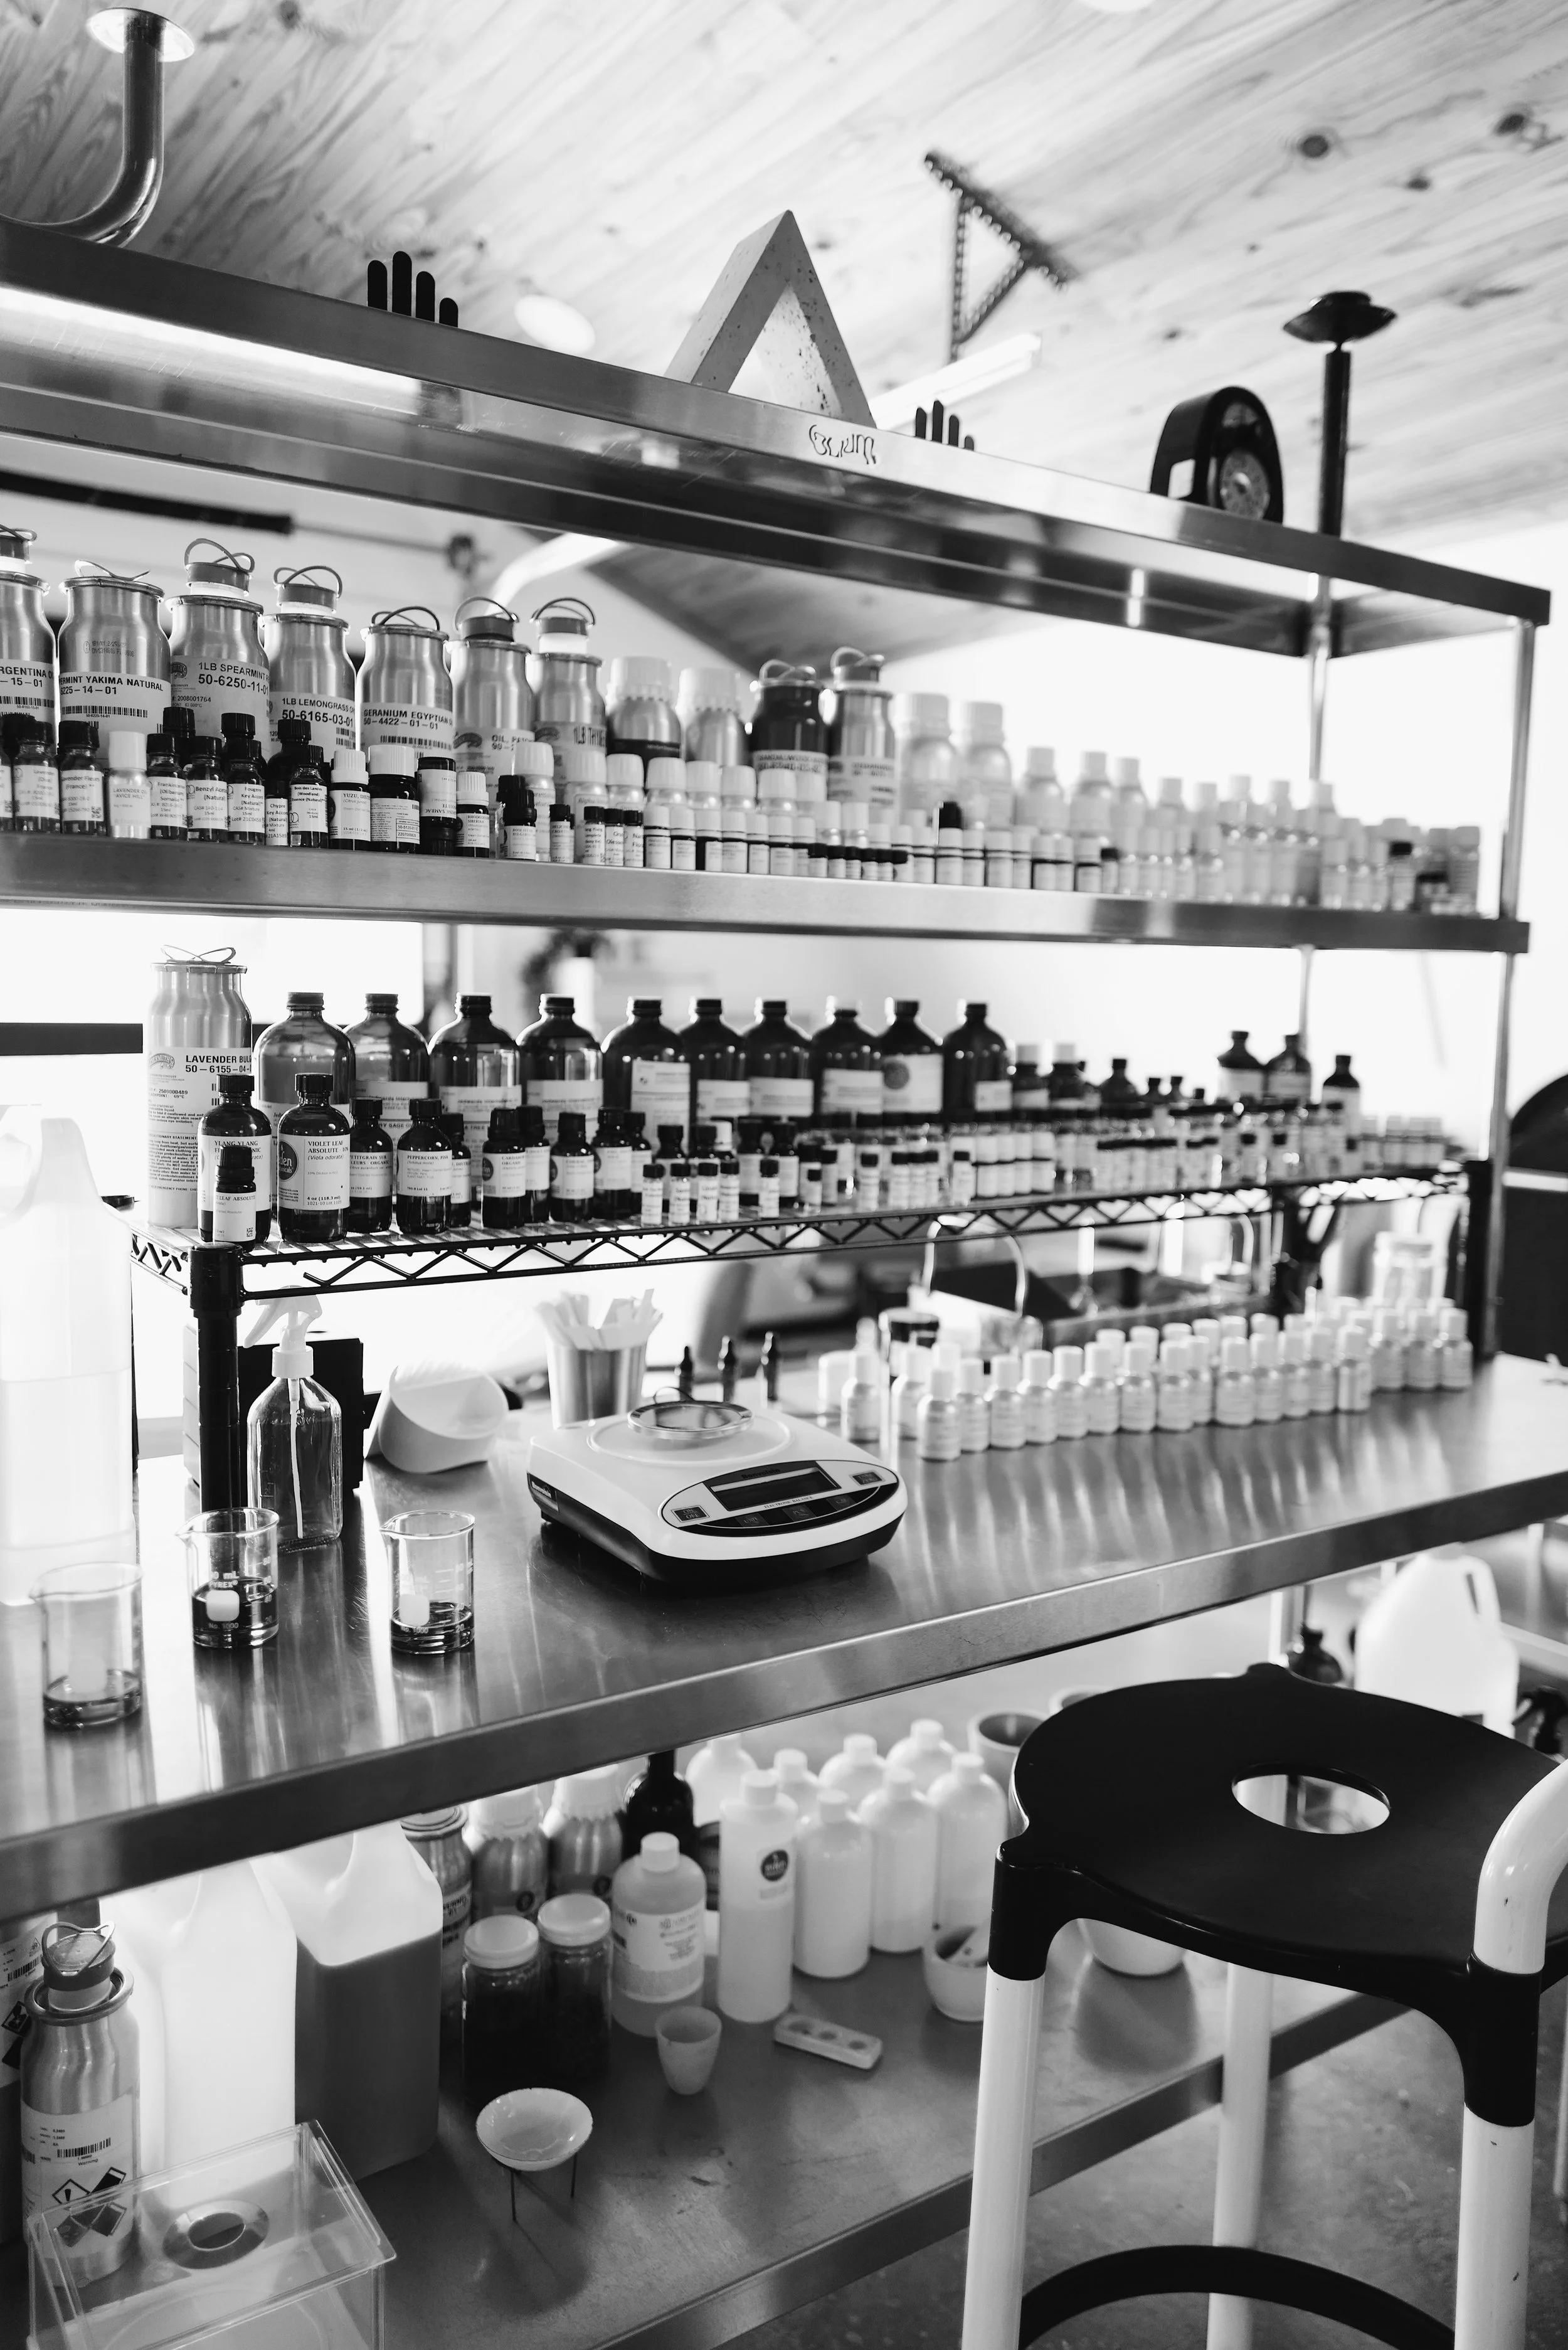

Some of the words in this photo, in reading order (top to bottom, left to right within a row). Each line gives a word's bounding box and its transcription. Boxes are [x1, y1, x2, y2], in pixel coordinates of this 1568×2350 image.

[199, 662, 217, 671] 1LB
[220, 664, 265, 681] SPEARMINT
[86, 676, 123, 685] YAKIMA
[127, 678, 163, 691] NATURAL
[198, 674, 268, 695] 50-6250-11-01
[299, 698, 349, 713] LEMONGRASS
[282, 709, 353, 727] 50-6165-03-01
[363, 709, 408, 718] GERANIUM
[411, 711, 448, 724] EGYPTIAN
[186, 1055, 237, 1063] LAVENDER
[763, 1500, 792, 1509] ELECTRONIC
[792, 1496, 813, 1504] BALANCE
[456, 1624, 465, 1632] 20
